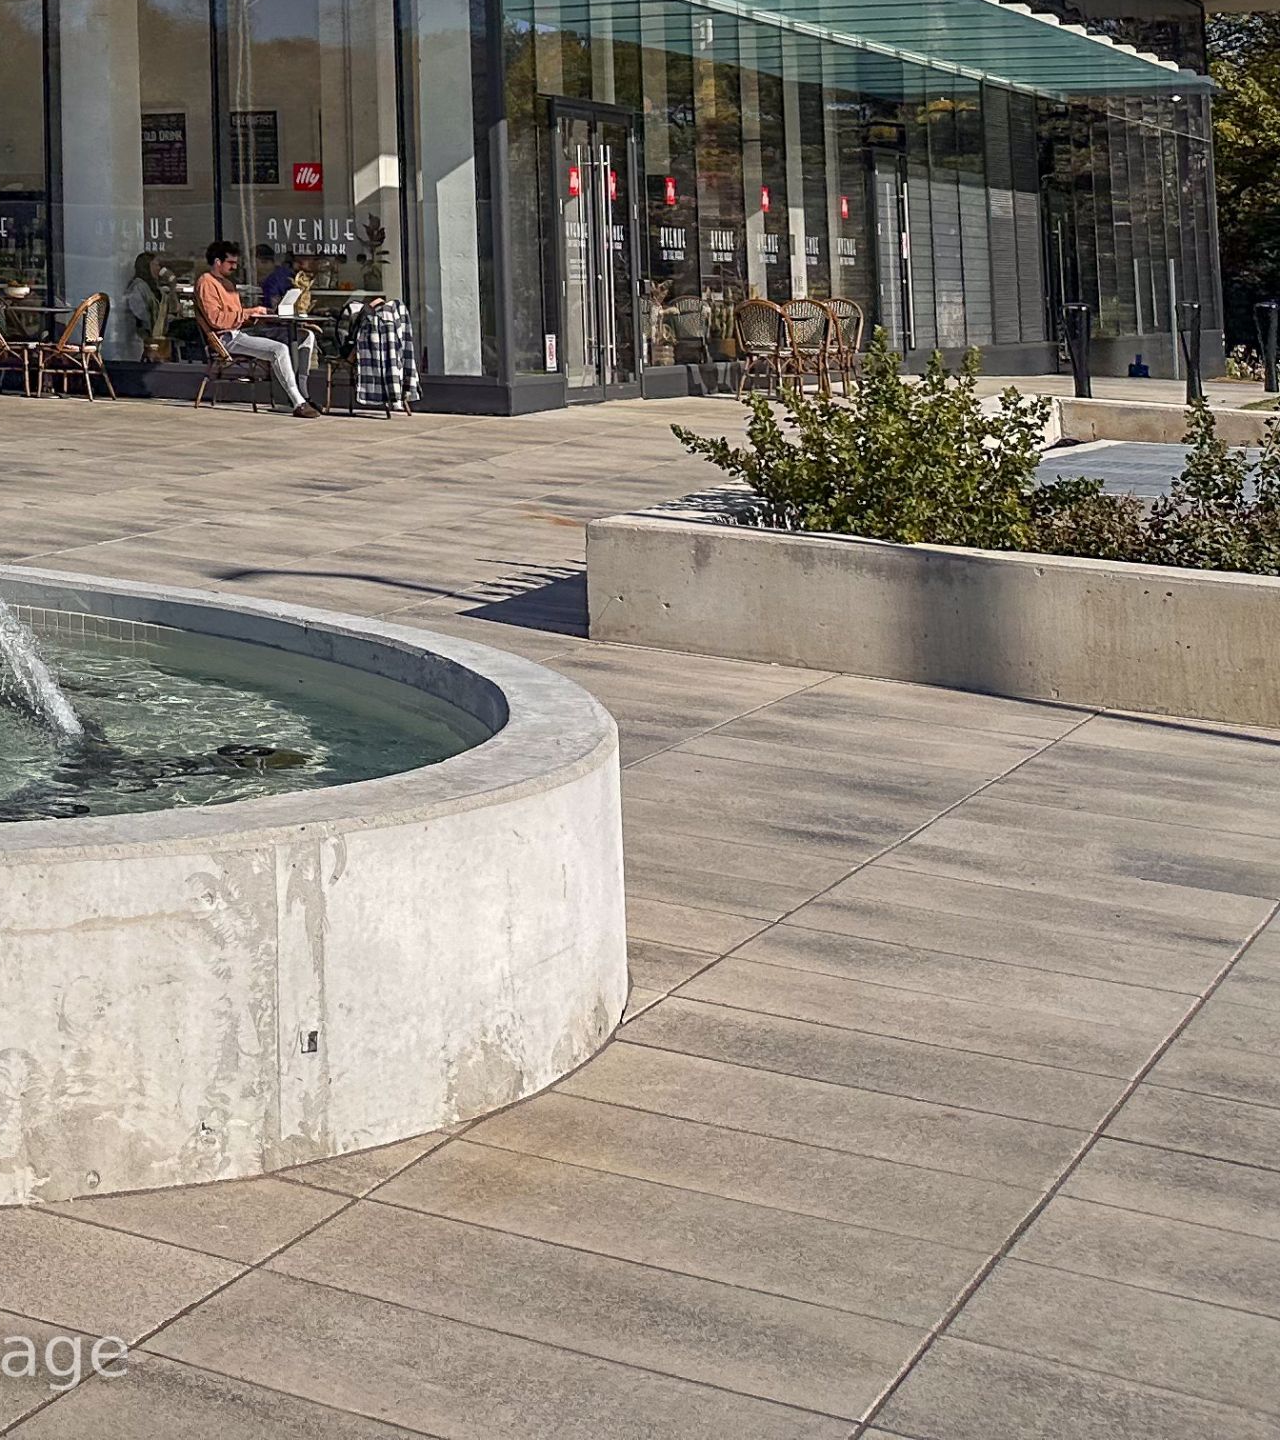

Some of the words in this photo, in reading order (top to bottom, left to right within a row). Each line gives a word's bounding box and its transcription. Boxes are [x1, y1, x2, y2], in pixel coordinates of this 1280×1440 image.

[295, 167, 320, 188] illy
[267, 218, 355, 241] AVENUE
[145, 241, 166, 252] ARK
[274, 243, 287, 254] ON
[292, 243, 314, 255] THE
[317, 243, 346, 255] PARK
